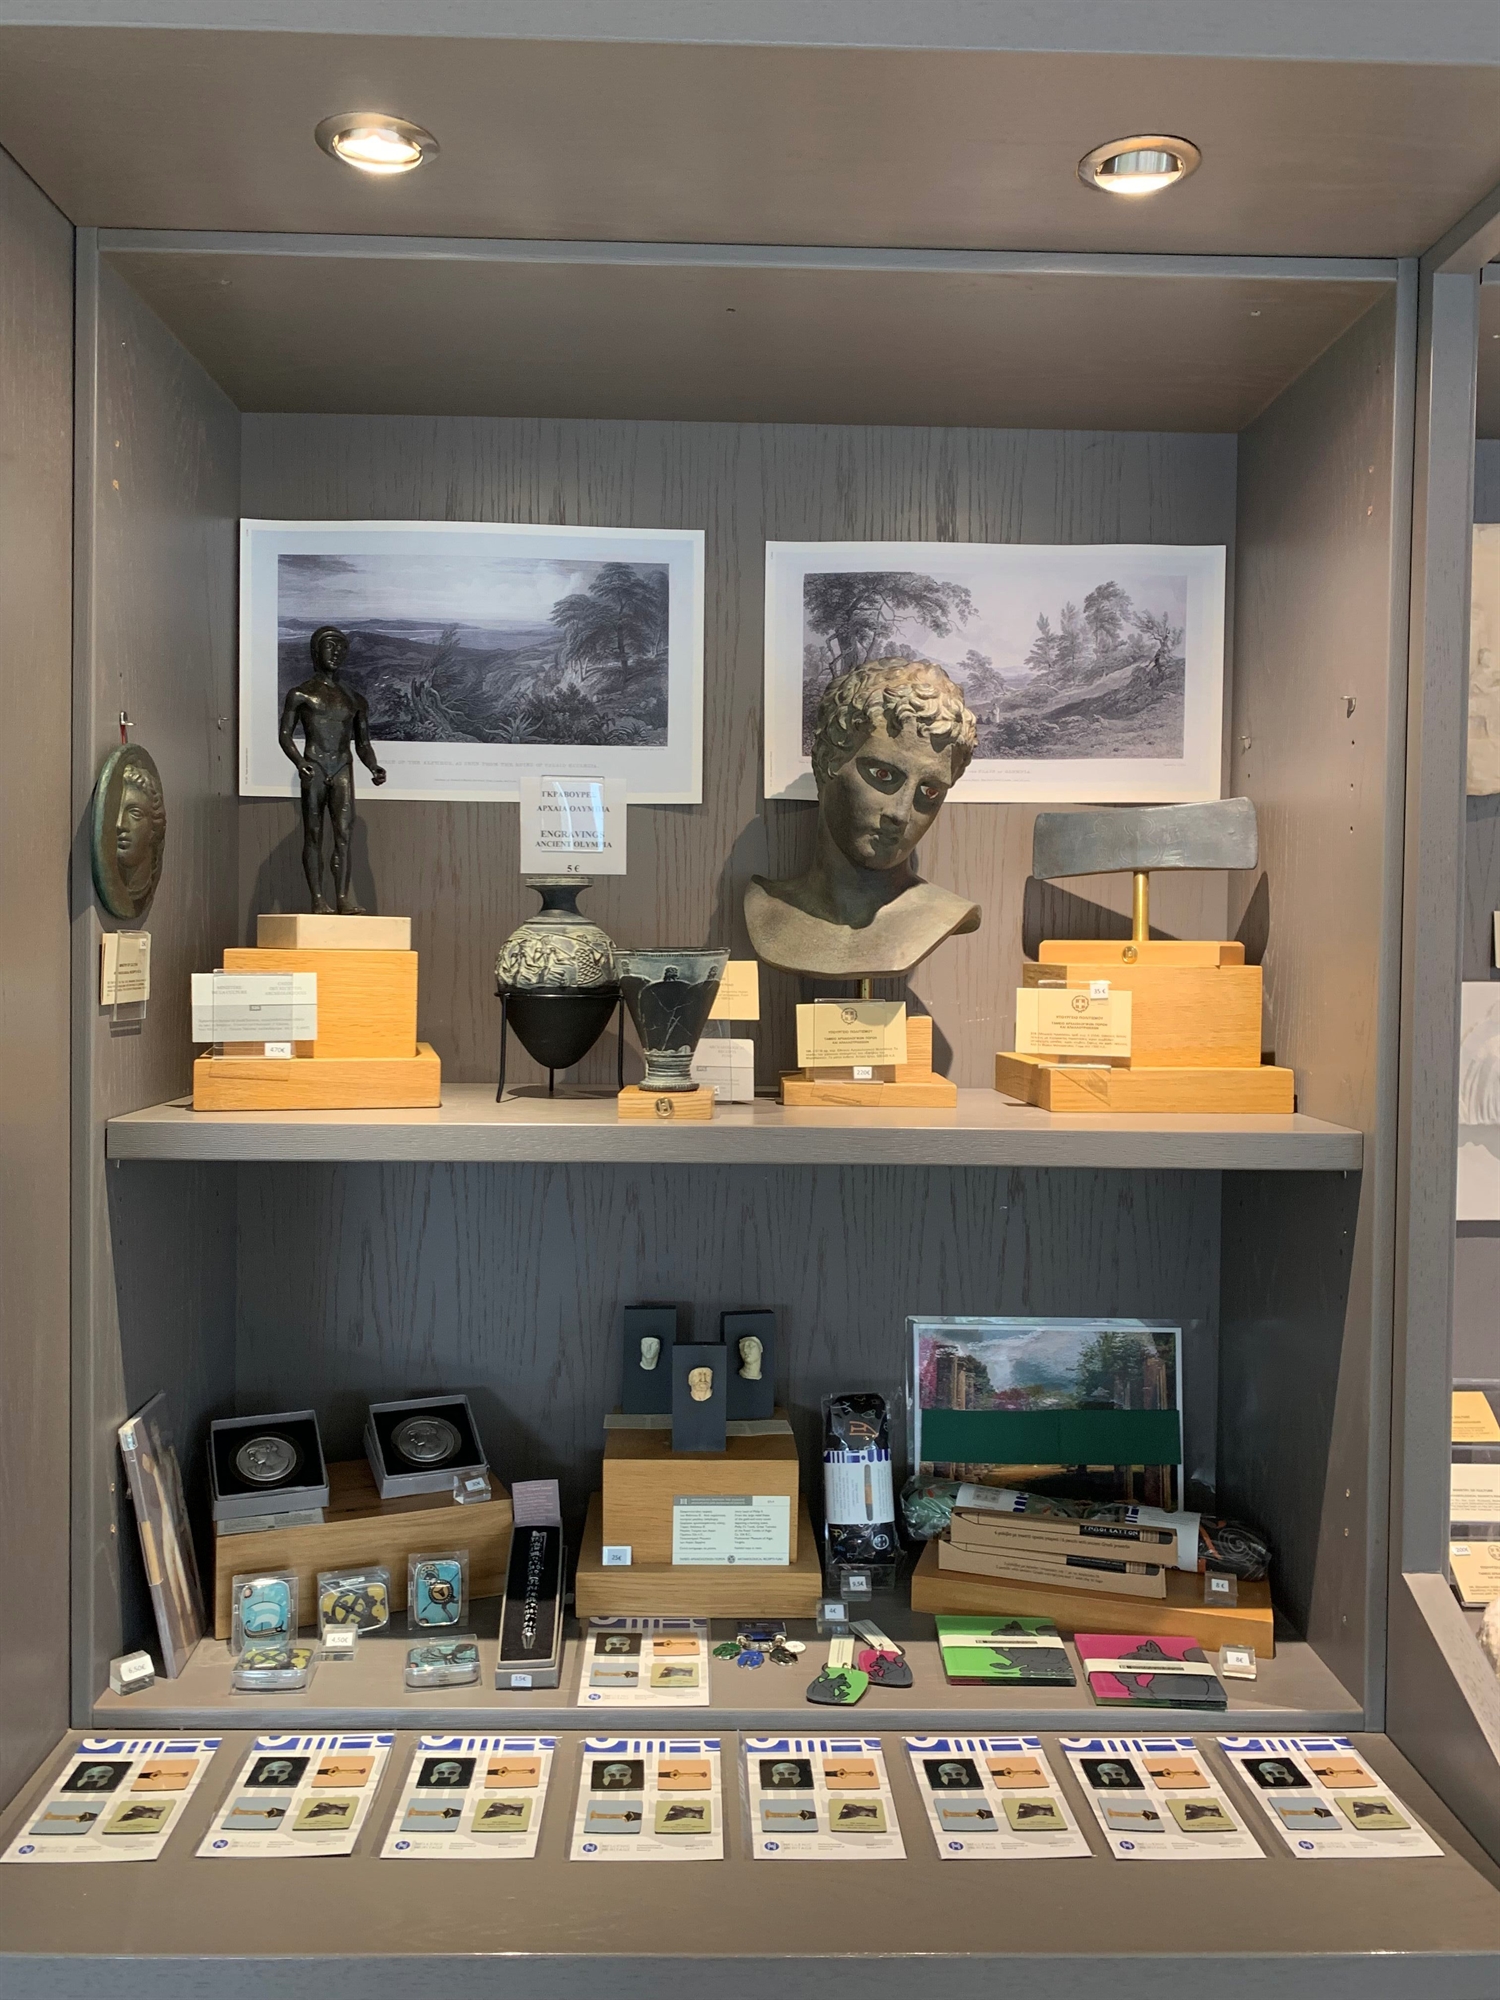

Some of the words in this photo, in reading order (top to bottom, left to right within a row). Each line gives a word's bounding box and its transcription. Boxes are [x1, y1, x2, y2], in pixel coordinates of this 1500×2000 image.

[541, 830, 606, 839] ENGRAVINGS
[535, 840, 572, 849] ANCIENT
[567, 864, 572, 873] 5
[574, 864, 581, 873] €
[270, 1046, 286, 1054] 470€
[611, 1554, 622, 1562] 25€
[331, 1636, 349, 1644] 4,50€
[1235, 1656, 1244, 1664] 8€
[128, 1664, 146, 1674] 6,50€
